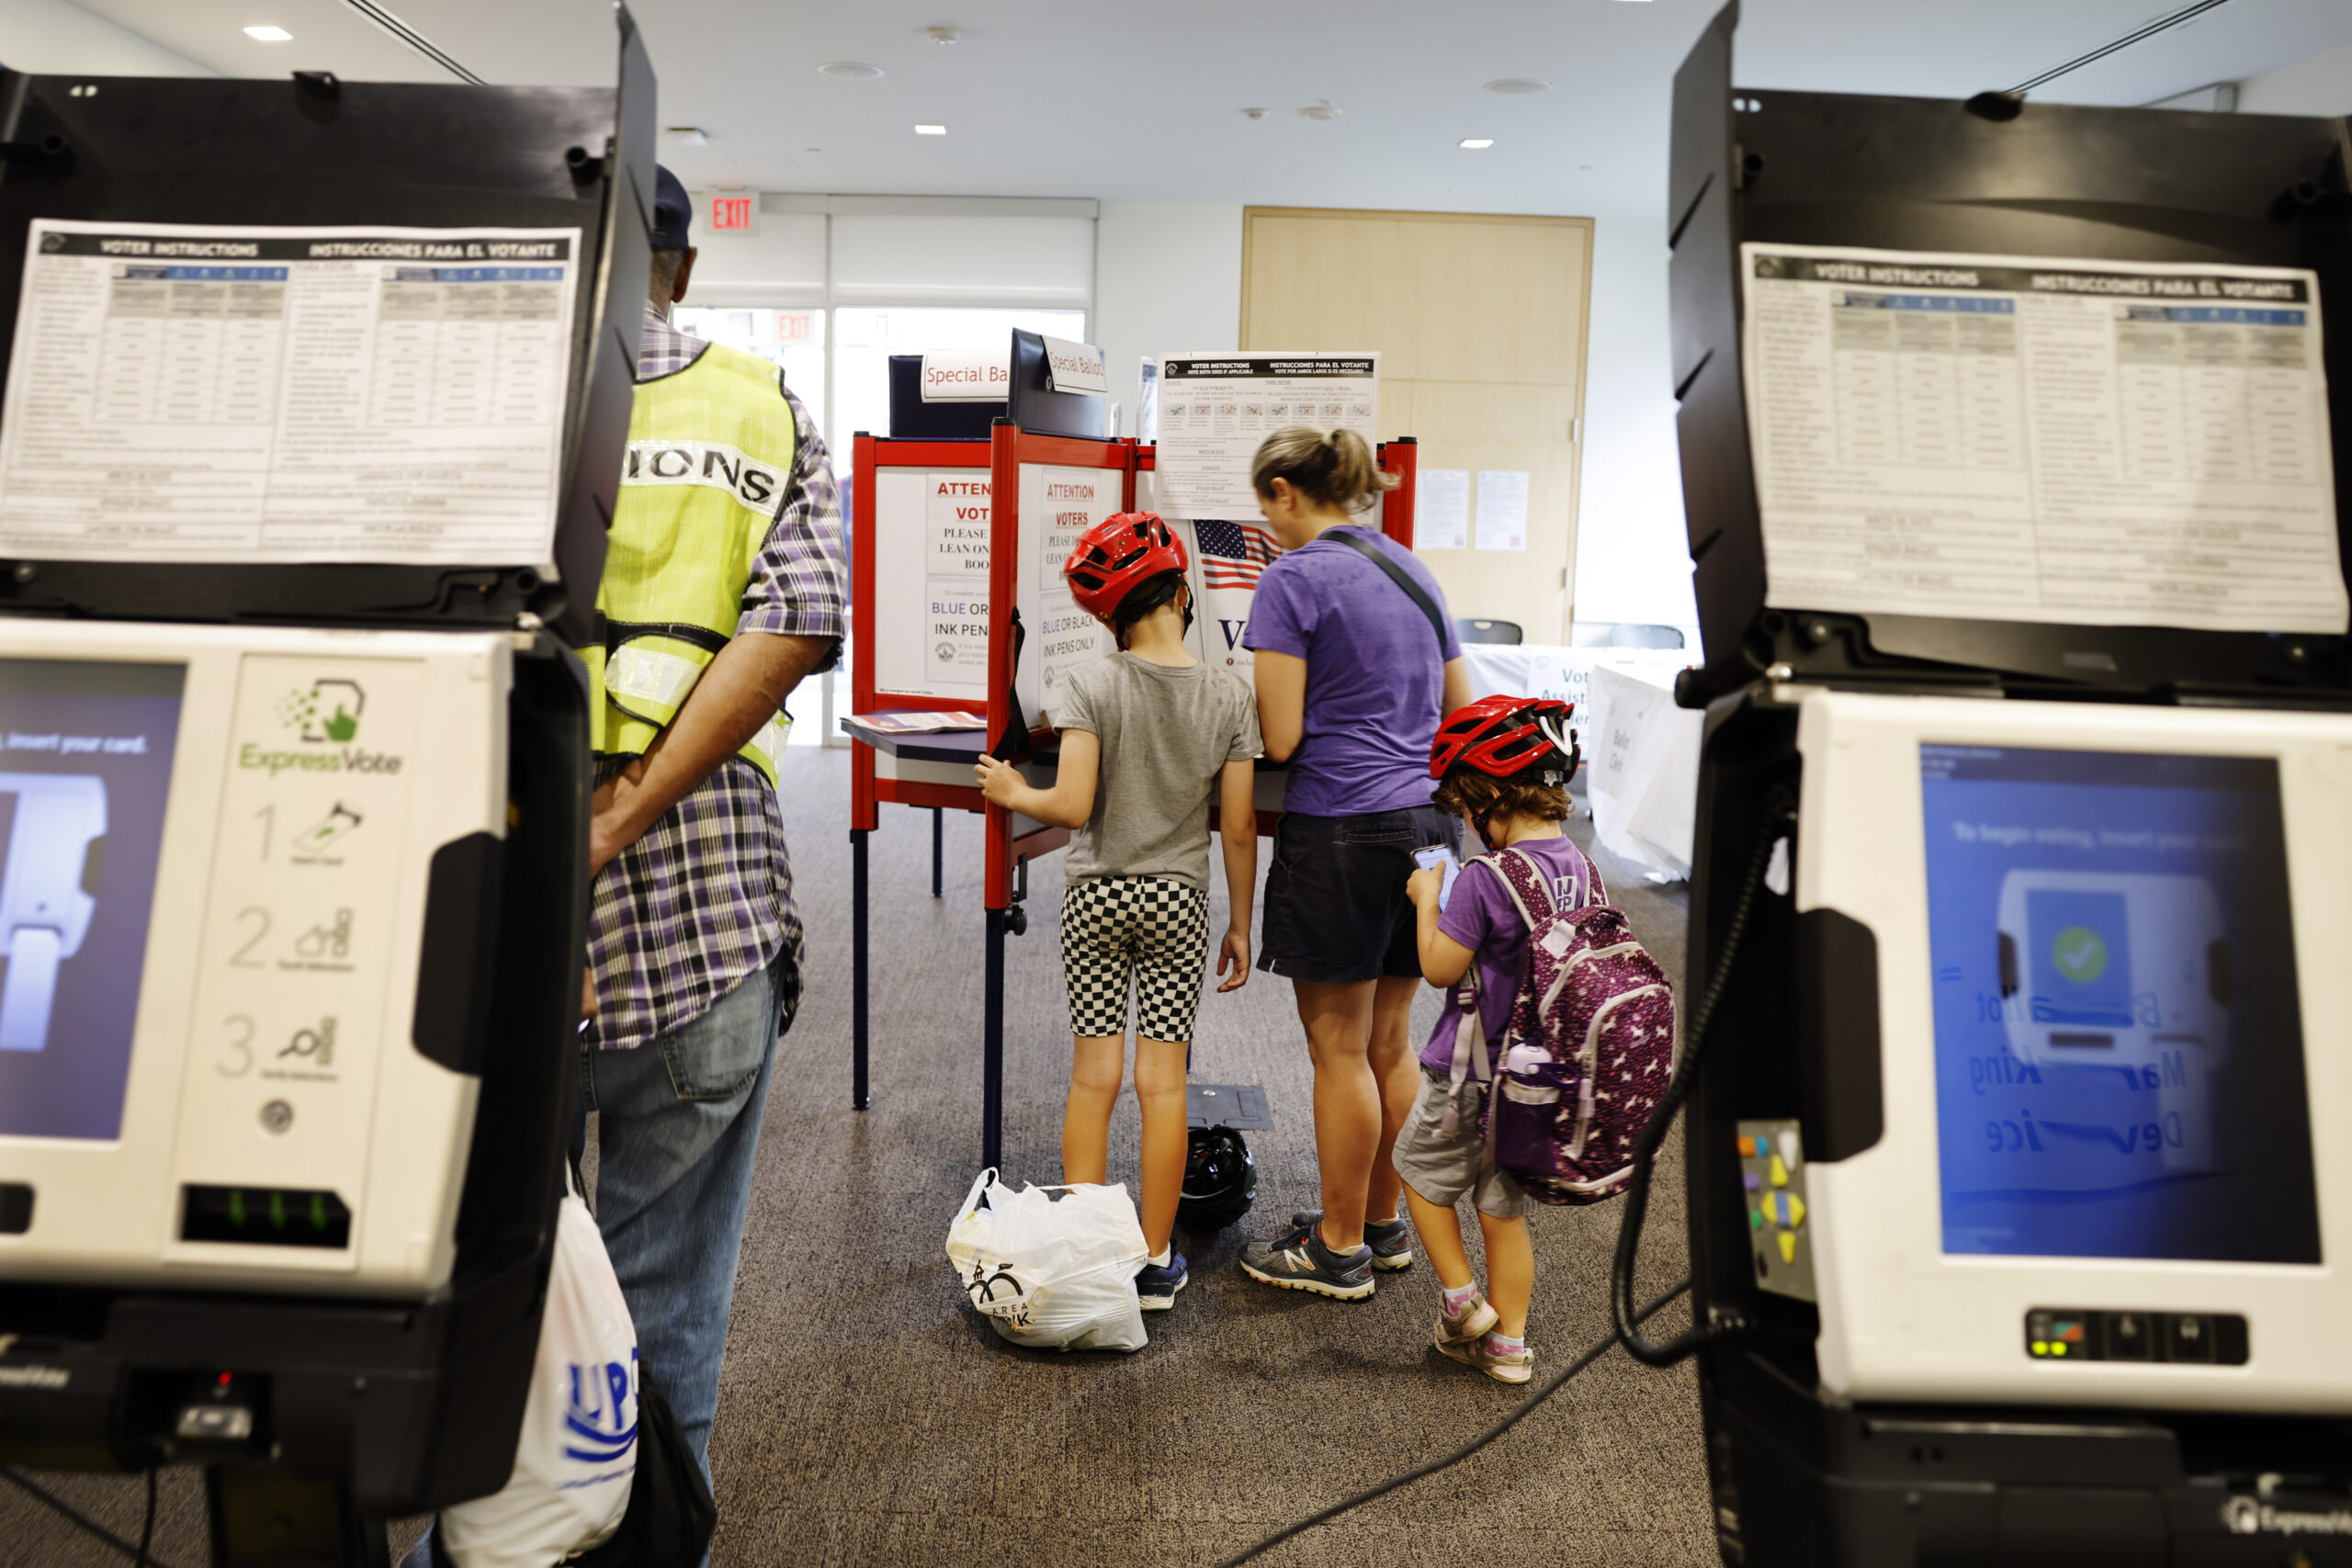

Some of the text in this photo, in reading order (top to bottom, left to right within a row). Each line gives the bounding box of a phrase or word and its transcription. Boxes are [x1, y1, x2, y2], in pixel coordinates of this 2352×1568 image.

[713, 198, 752, 230] EXIT
[100, 240, 259, 257] VOTER INSTRUCTIONS
[309, 243, 556, 258] INSTRUCCIONES PARA EL VOTANTE
[1815, 263, 1979, 288] VOTER INSTRUCTIONS
[2030, 275, 2295, 299] INSTRUCCIONES PARA EL VOTANTE
[779, 316, 811, 340] EXIT
[1049, 352, 1103, 377] Special Ballot
[927, 367, 983, 387] Special
[628, 449, 775, 504] IONS
[937, 482, 991, 495] ATTEN
[1047, 483, 1094, 499] ATTENTION
[956, 507, 989, 520] VOT
[1056, 512, 1088, 525] VOTERS
[944, 528, 988, 538] PLEASE
[1049, 536, 1071, 547] PLEASE
[939, 543, 970, 554] LEAN
[932, 603, 989, 615] BLUE OR
[934, 623, 988, 637] INK PEN
[1043, 615, 1094, 634] BLUE OR BLACK
[1217, 618, 1247, 651] V
[1044, 637, 1095, 659] INK PENS ONLY
[1563, 669, 1589, 684] Vot
[238, 742, 403, 777] ExpressVote
[254, 803, 277, 863] 1
[228, 905, 273, 968] 2
[215, 1012, 257, 1078] 3
[992, 1302, 1029, 1316] AREA
